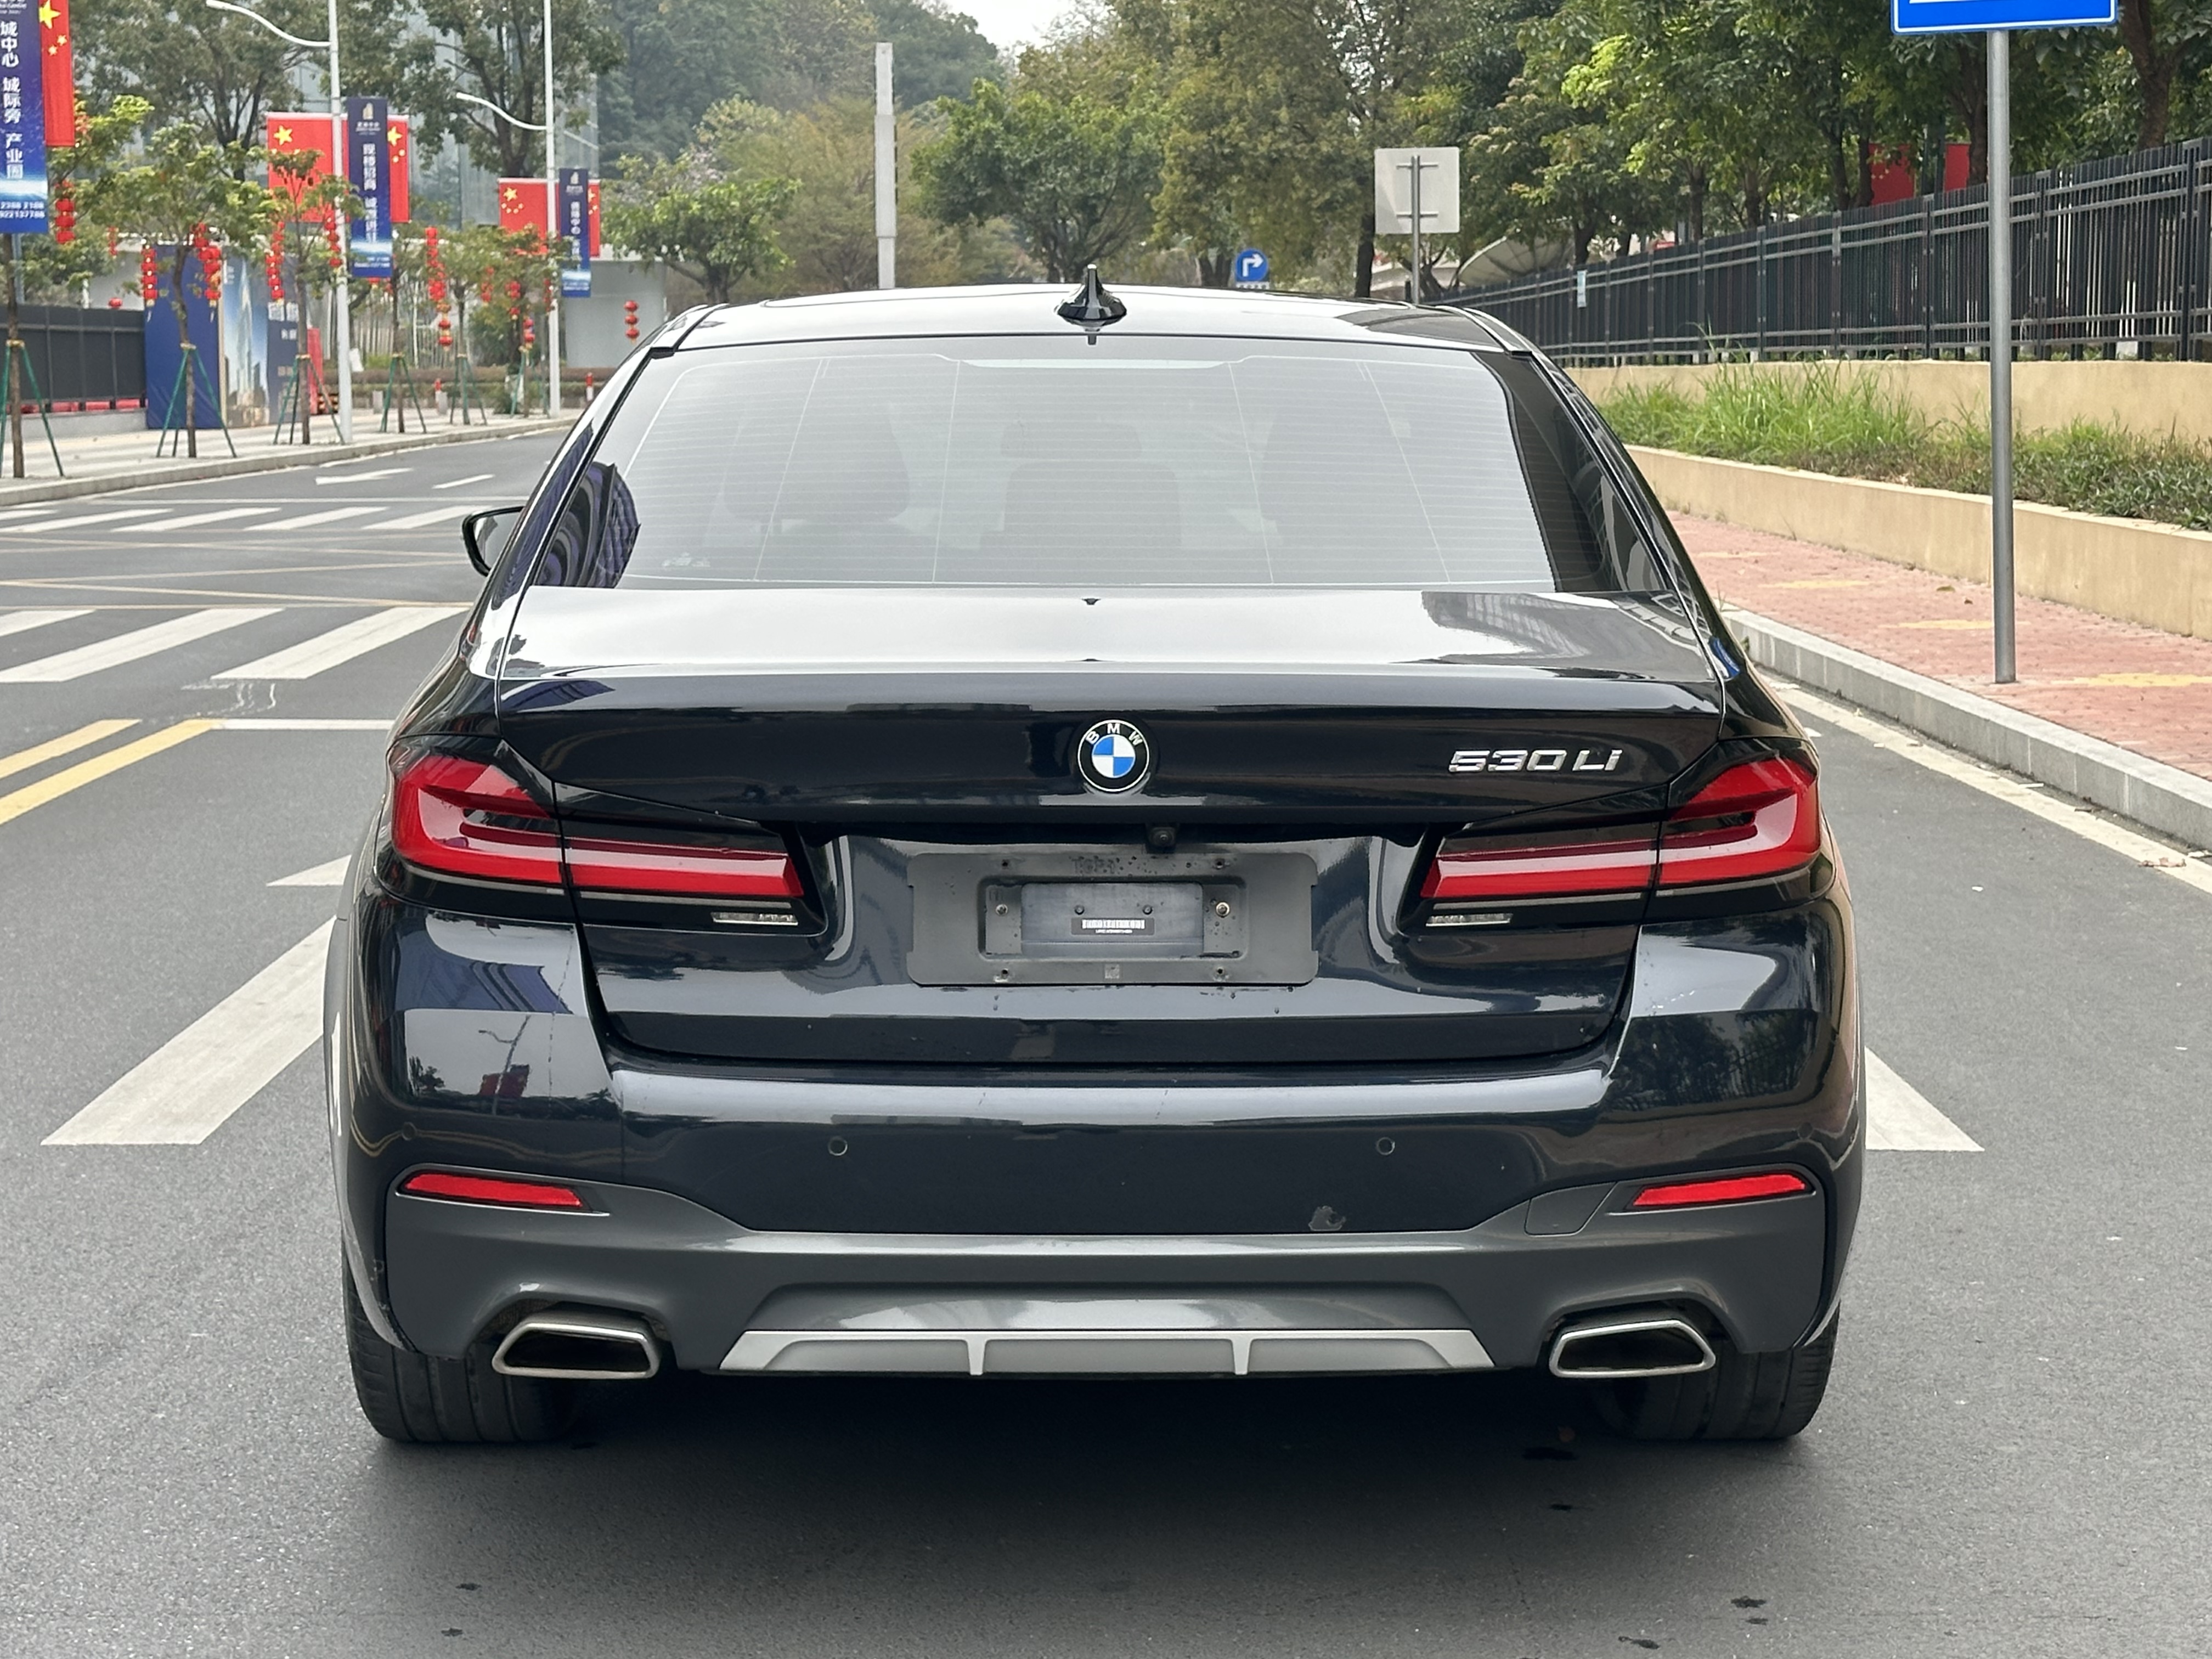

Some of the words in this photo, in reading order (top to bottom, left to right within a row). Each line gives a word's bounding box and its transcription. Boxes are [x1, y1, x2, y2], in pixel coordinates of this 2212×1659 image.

[0, 21, 19, 68] 城中心
[1086, 723, 1143, 746] BMW
